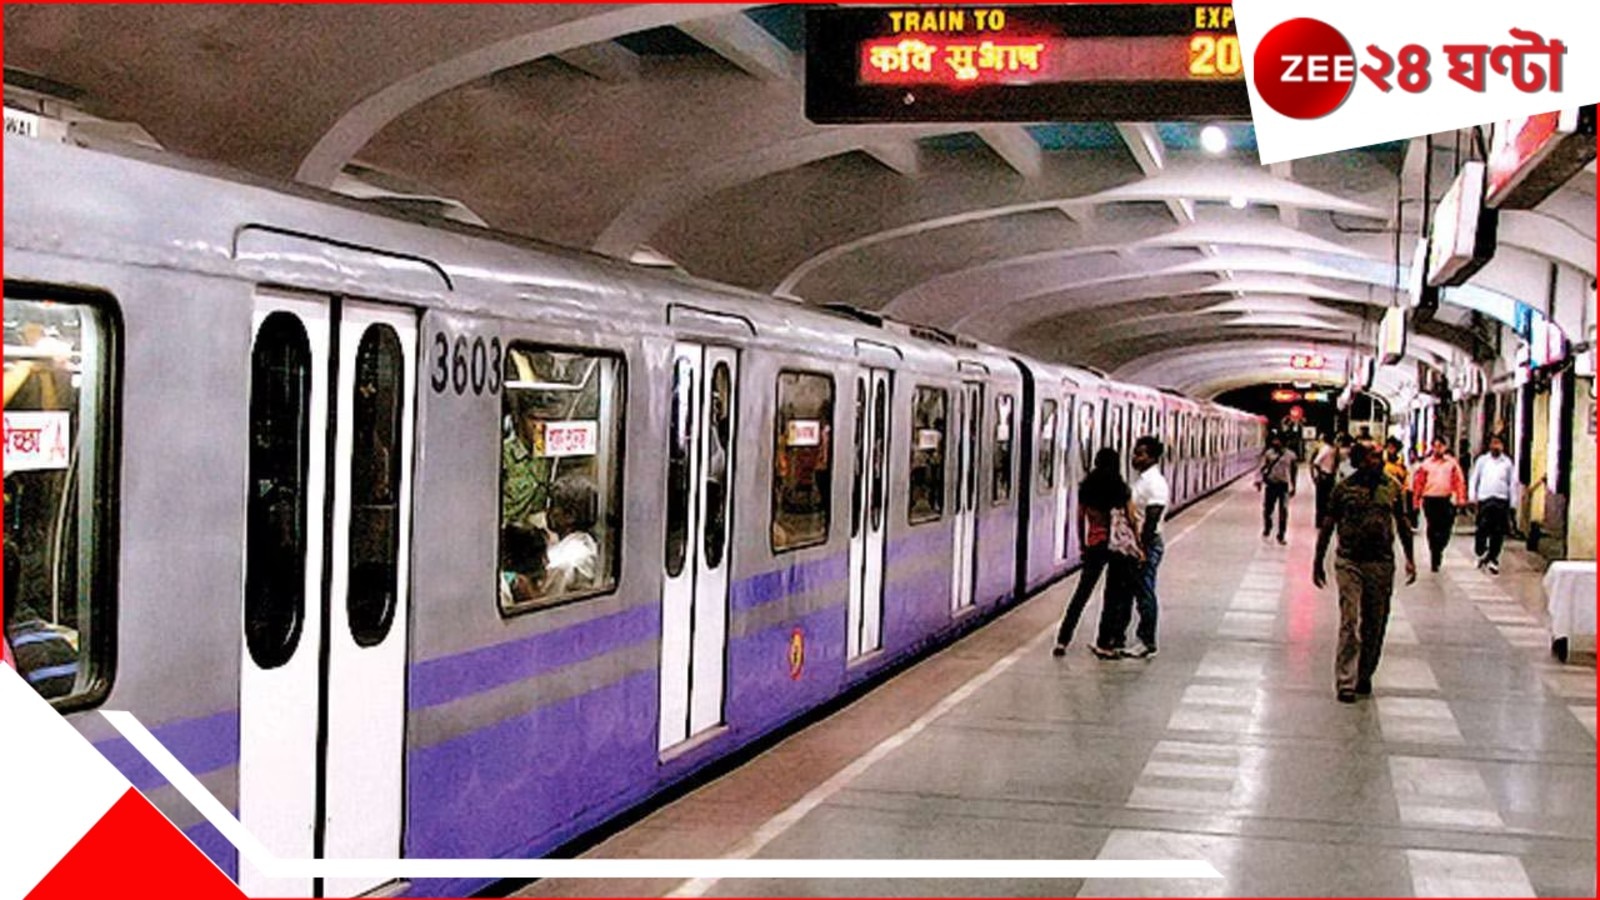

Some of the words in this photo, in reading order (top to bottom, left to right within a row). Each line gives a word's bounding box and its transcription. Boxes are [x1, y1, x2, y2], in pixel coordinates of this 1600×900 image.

[889, 11, 963, 32] TRAIN
[974, 9, 1005, 31] TO
[1195, 6, 1234, 29] EXP
[870, 40, 937, 73] कवि
[1189, 35, 1240, 75] 20
[431, 331, 501, 396] 3603
